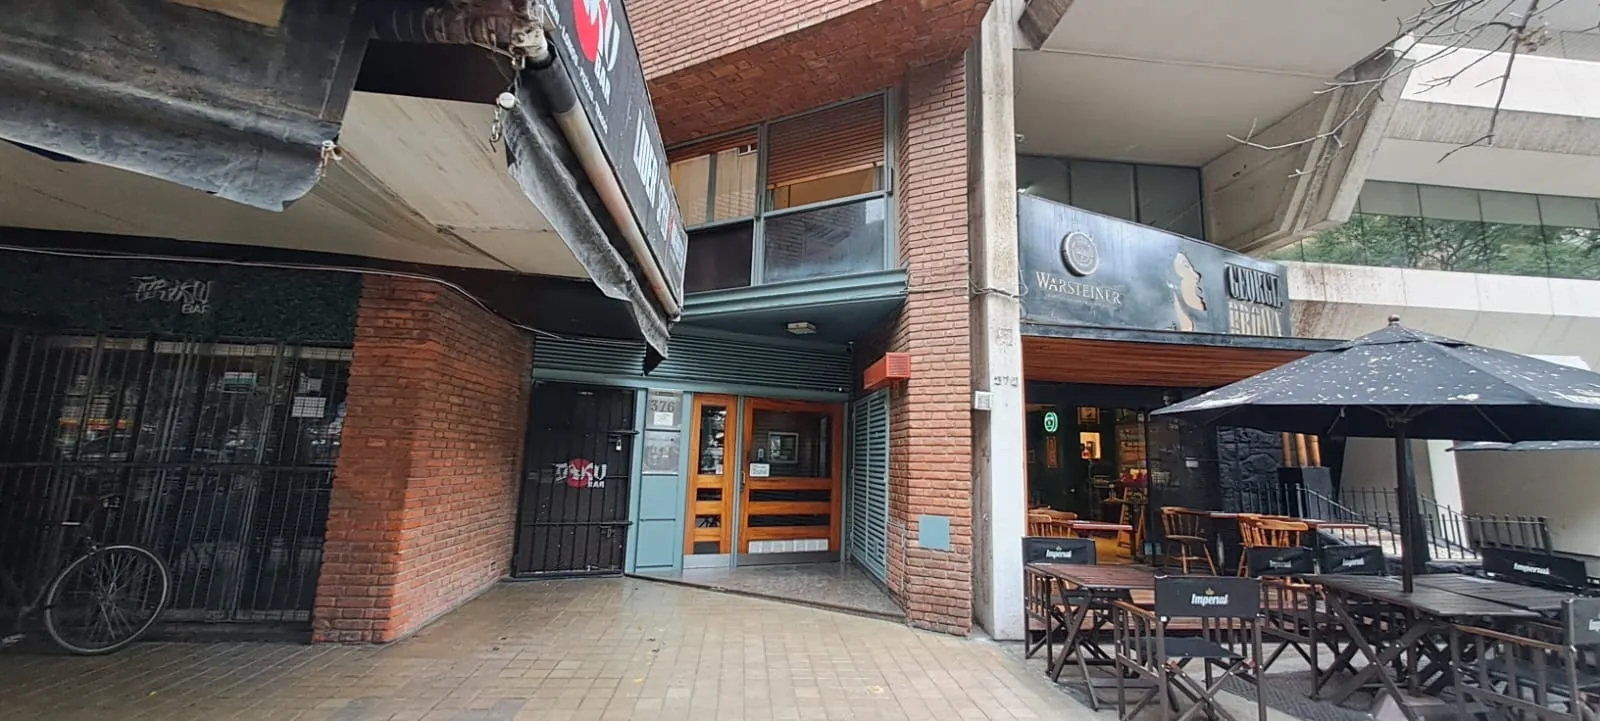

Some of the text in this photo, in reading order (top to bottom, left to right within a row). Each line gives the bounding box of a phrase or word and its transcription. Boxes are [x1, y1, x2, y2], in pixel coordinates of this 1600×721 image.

[594, 50, 611, 105] BAR
[1035, 271, 1122, 305] WARSTEINER
[650, 399, 675, 412] 376
[588, 480, 605, 488] BAR
[1191, 592, 1229, 607] Imperial
